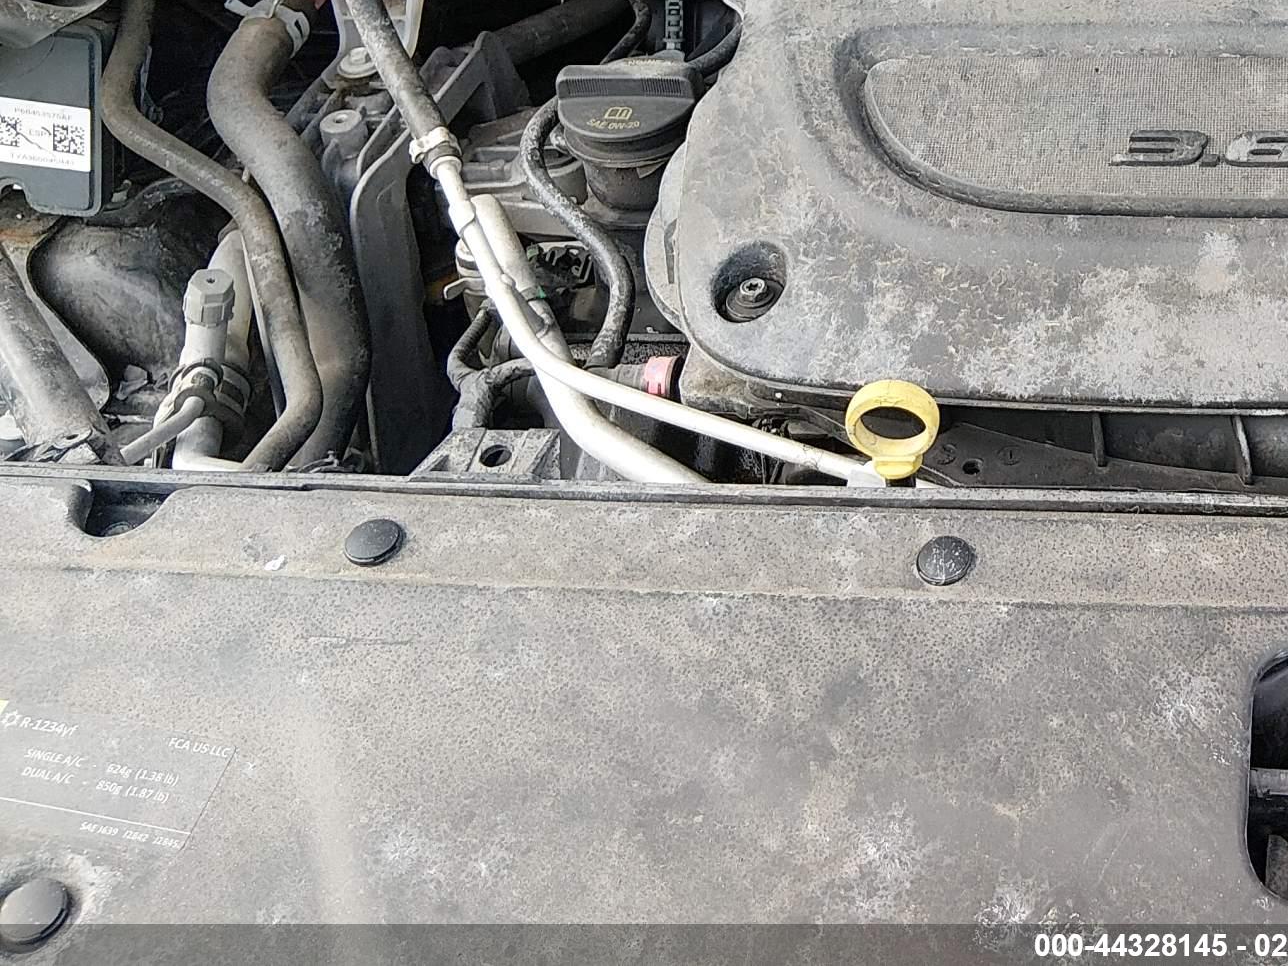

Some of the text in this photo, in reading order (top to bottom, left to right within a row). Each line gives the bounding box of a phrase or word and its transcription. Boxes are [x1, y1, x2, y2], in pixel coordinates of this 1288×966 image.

[20, 716, 79, 738] R-1234yf
[168, 737, 232, 758] FCA US LLC
[23, 748, 65, 764] SINGLE
[61, 753, 87, 768] A/C
[106, 763, 132, 779] 624g
[135, 768, 163, 783] (1.38
[163, 772, 180, 787] lb)
[21, 766, 53, 781] DUAL
[50, 772, 75, 785] A/C
[95, 780, 123, 796] 850g
[125, 785, 153, 800] (1.87
[153, 789, 170, 804] lb)
